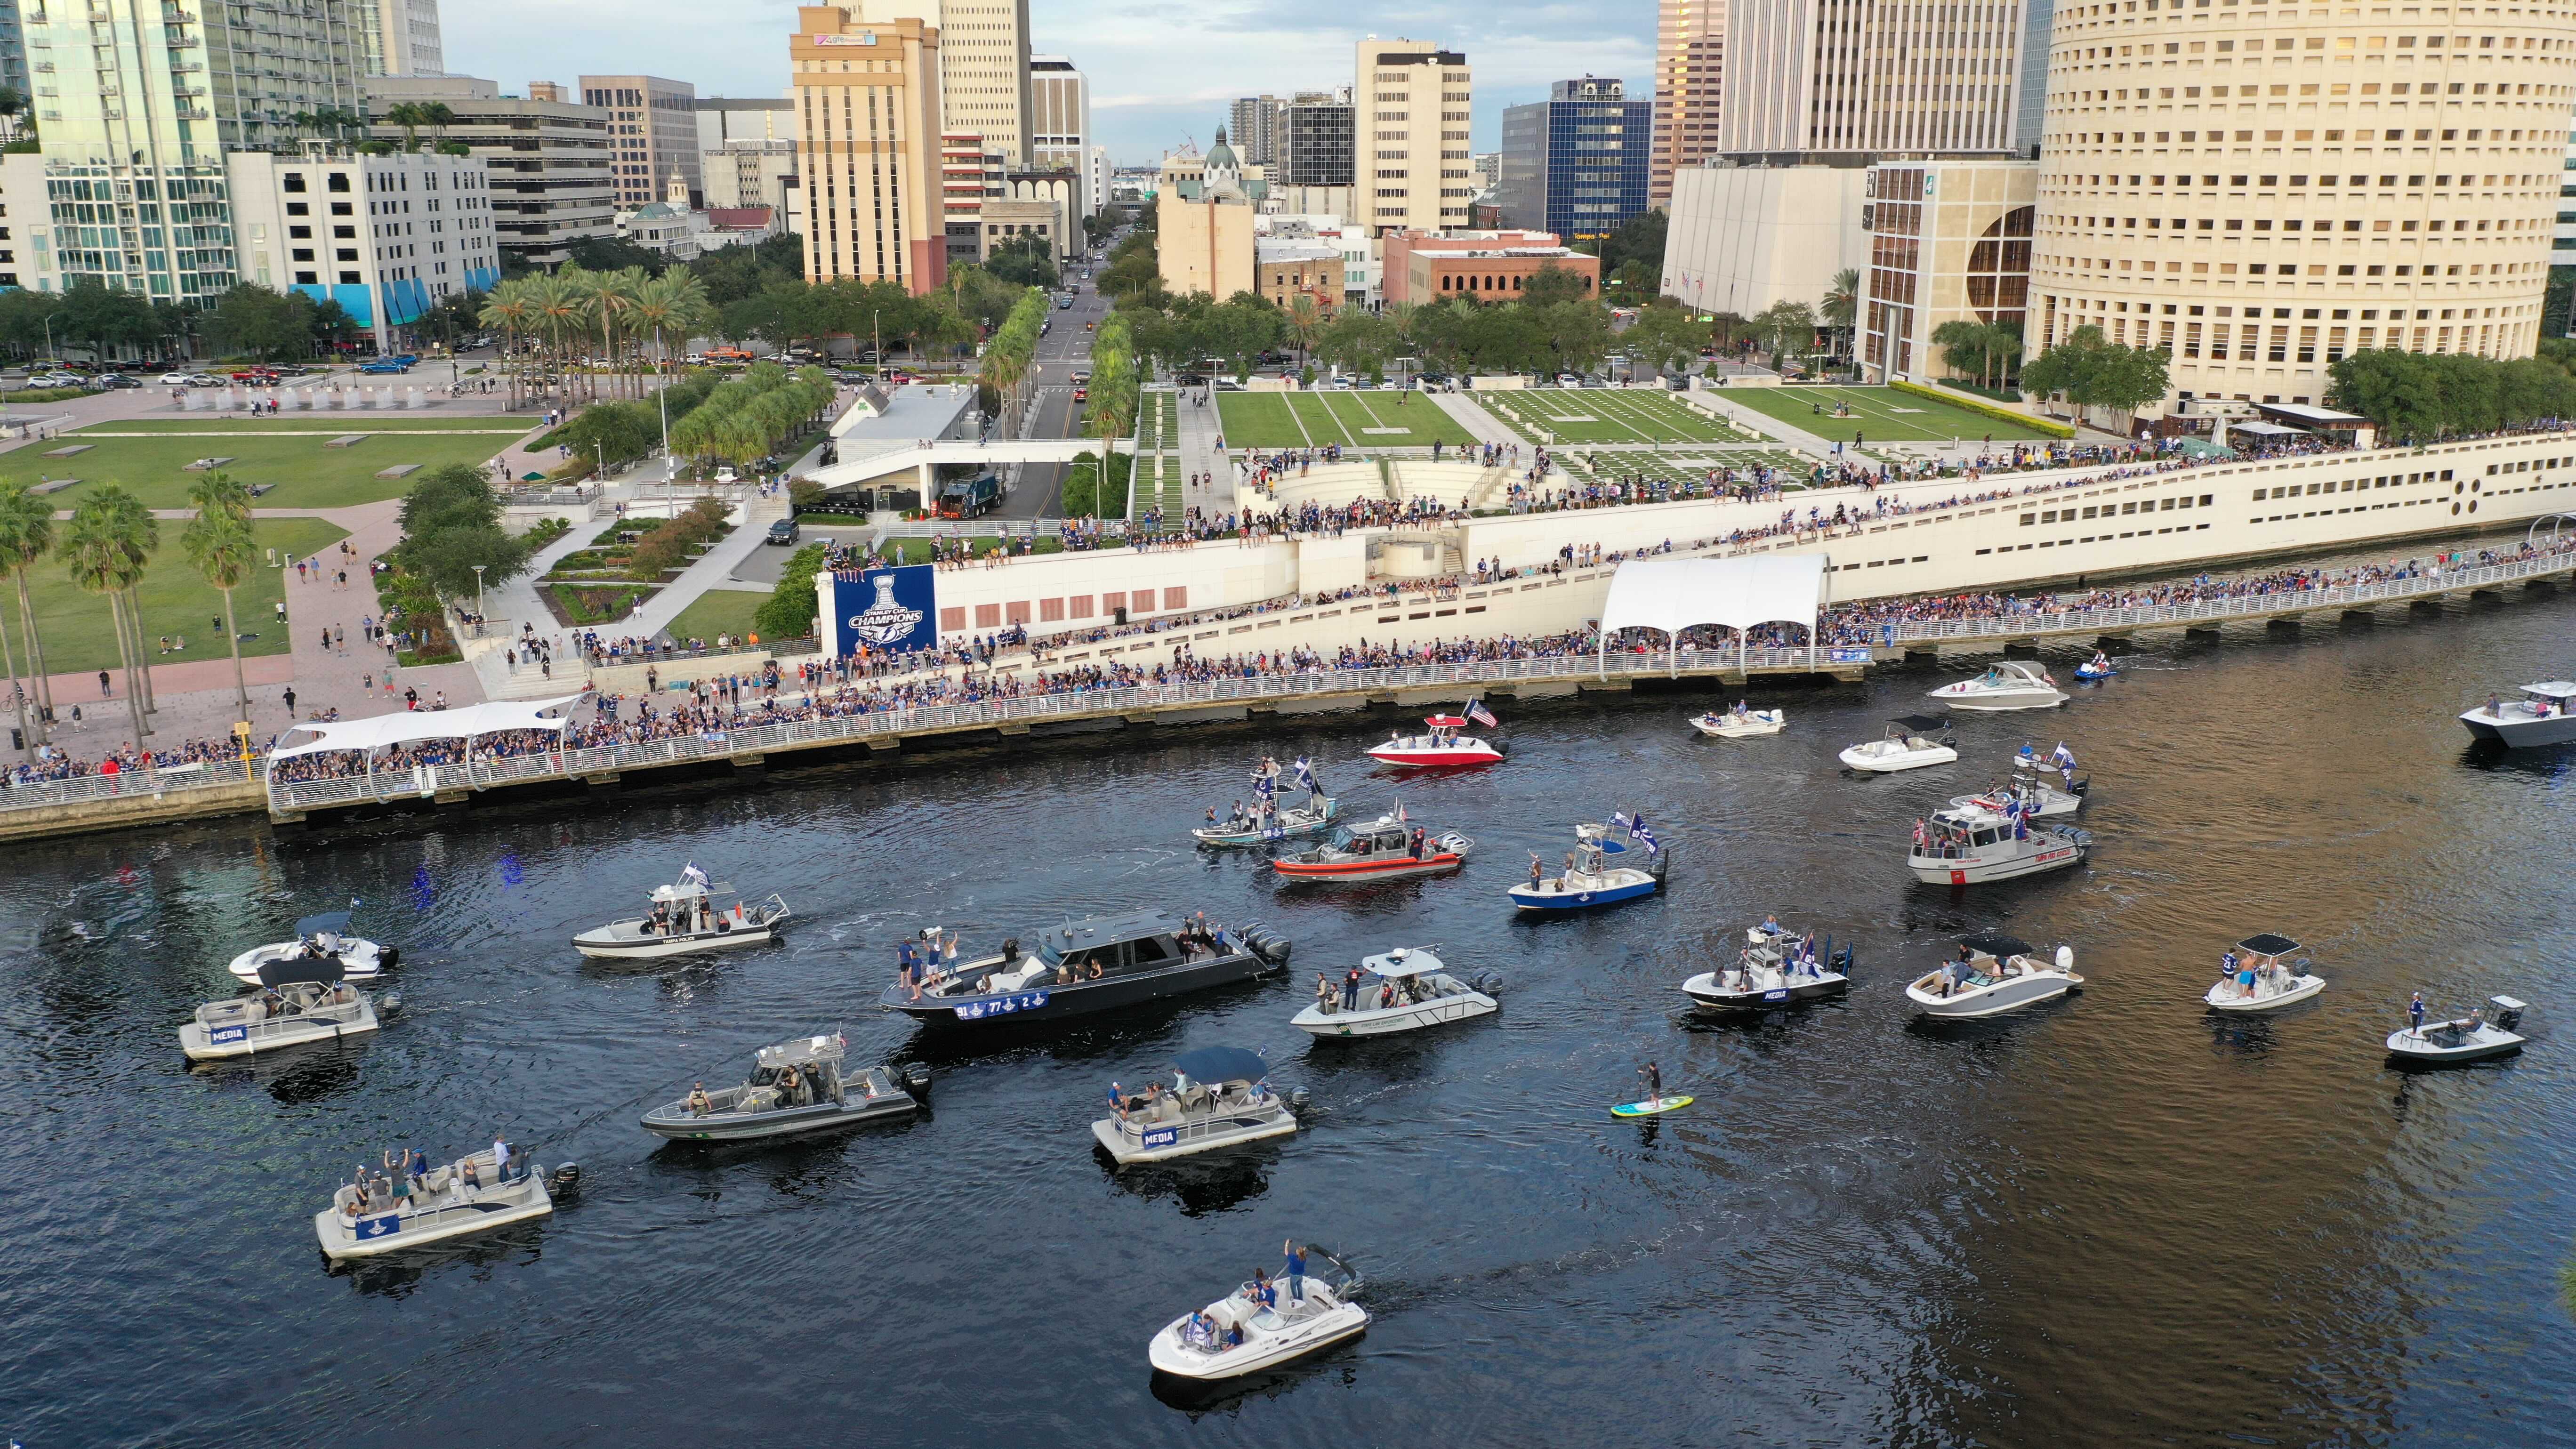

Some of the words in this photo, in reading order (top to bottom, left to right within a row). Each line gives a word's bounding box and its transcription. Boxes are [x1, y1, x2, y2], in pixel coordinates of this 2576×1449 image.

[1574, 233, 1595, 241] Tampa
[850, 612, 921, 627] CHAMPIONS
[1764, 990, 1787, 999] MEDIA
[990, 1001, 1001, 1013] 77
[1022, 997, 1029, 1007] 2
[957, 1006, 968, 1017] 91
[213, 1029, 243, 1041] MEDIA
[1145, 1132, 1174, 1145] MEDIA
